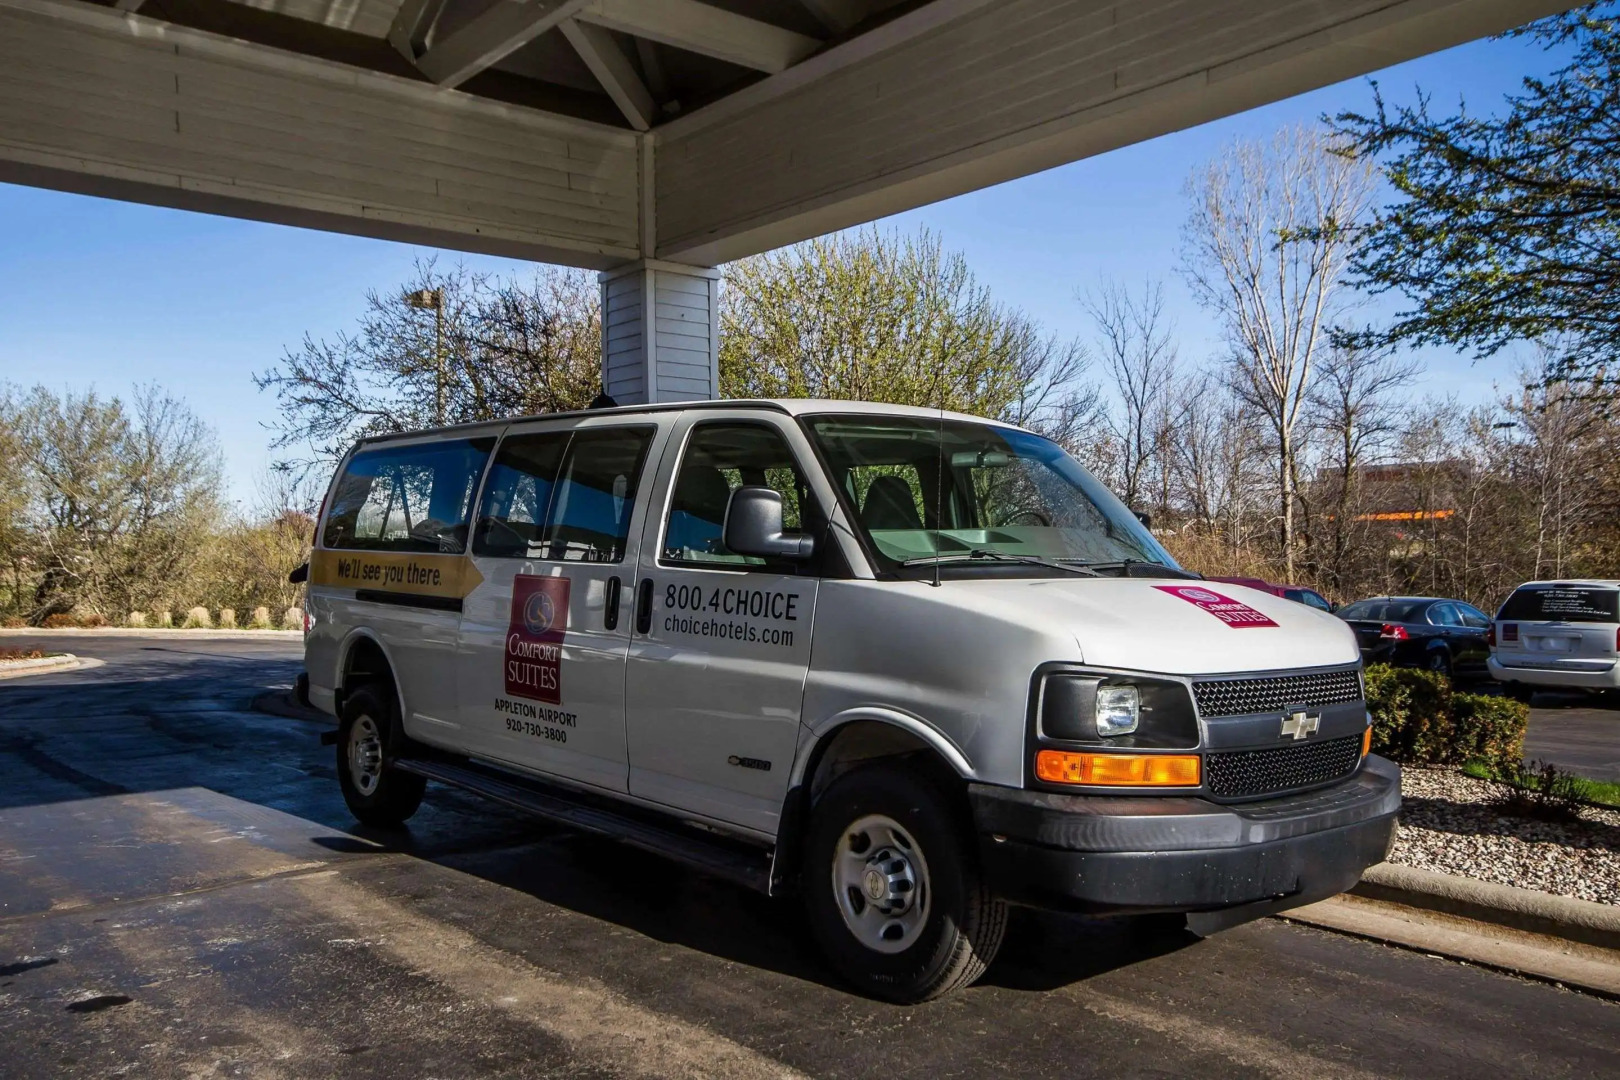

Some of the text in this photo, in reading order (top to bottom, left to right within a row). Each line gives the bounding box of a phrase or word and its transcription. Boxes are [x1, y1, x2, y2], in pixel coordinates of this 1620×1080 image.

[338, 558, 442, 586] We'll see you there.
[664, 584, 800, 621] 800.4CHOICE
[1214, 611, 1269, 623] SUITES
[664, 614, 794, 646] choicehotels.com
[508, 633, 559, 662] COMFORT
[508, 660, 557, 690] SUITES
[494, 698, 577, 728] APPLETON AIRPORT
[506, 718, 567, 744] 920-730-3800
